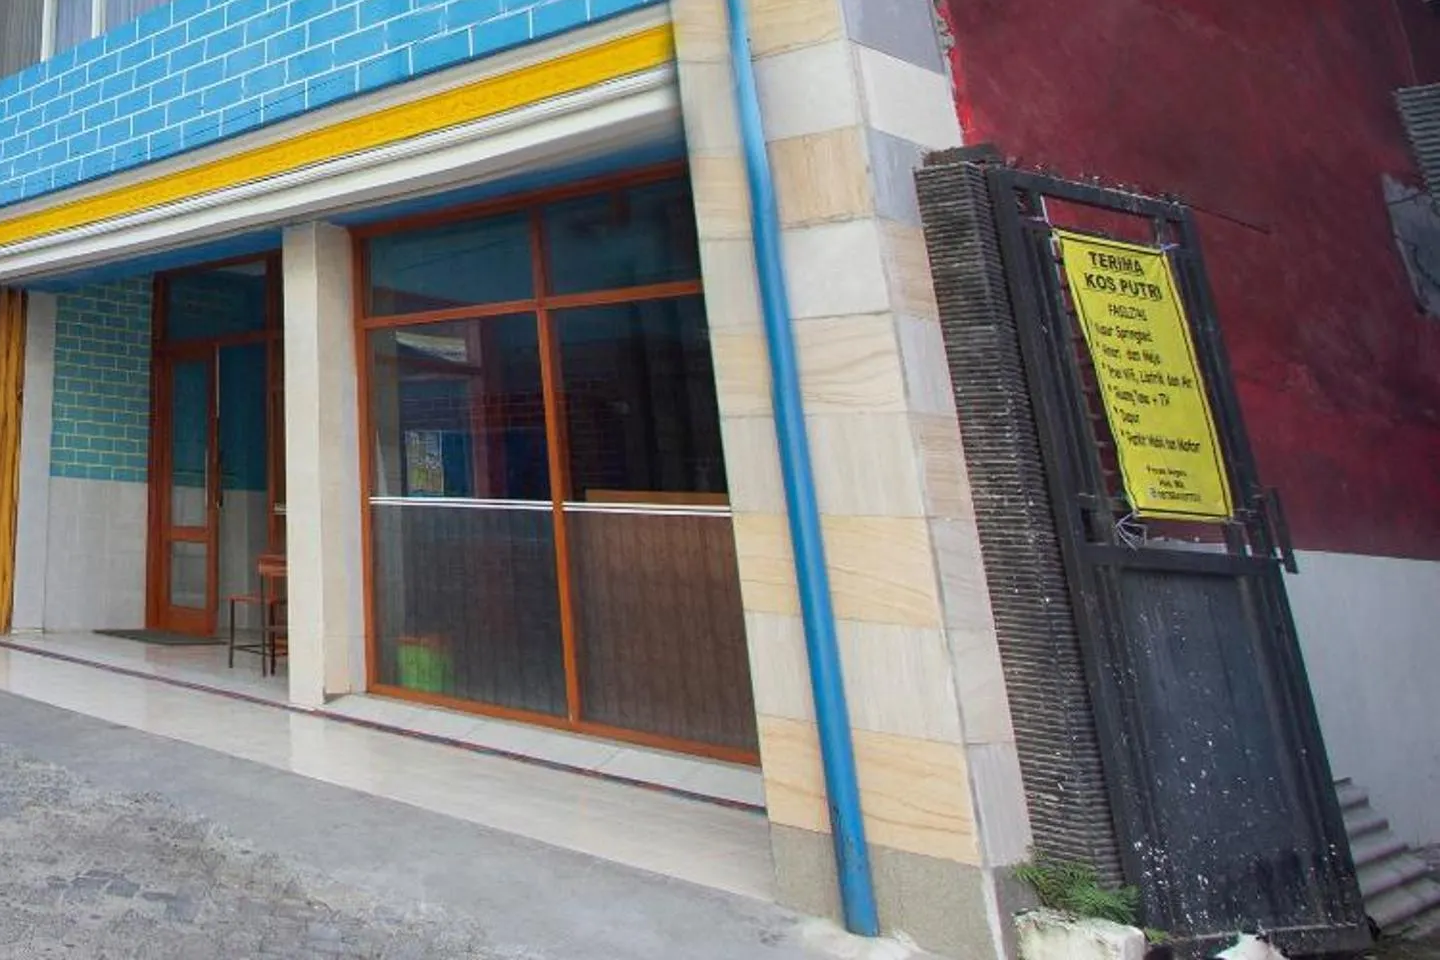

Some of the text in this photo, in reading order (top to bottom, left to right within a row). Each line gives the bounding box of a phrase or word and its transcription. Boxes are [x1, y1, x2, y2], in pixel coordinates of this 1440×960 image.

[1088, 251, 1144, 274] TERIMA
[1084, 273, 1162, 301] KOS PUTRI
